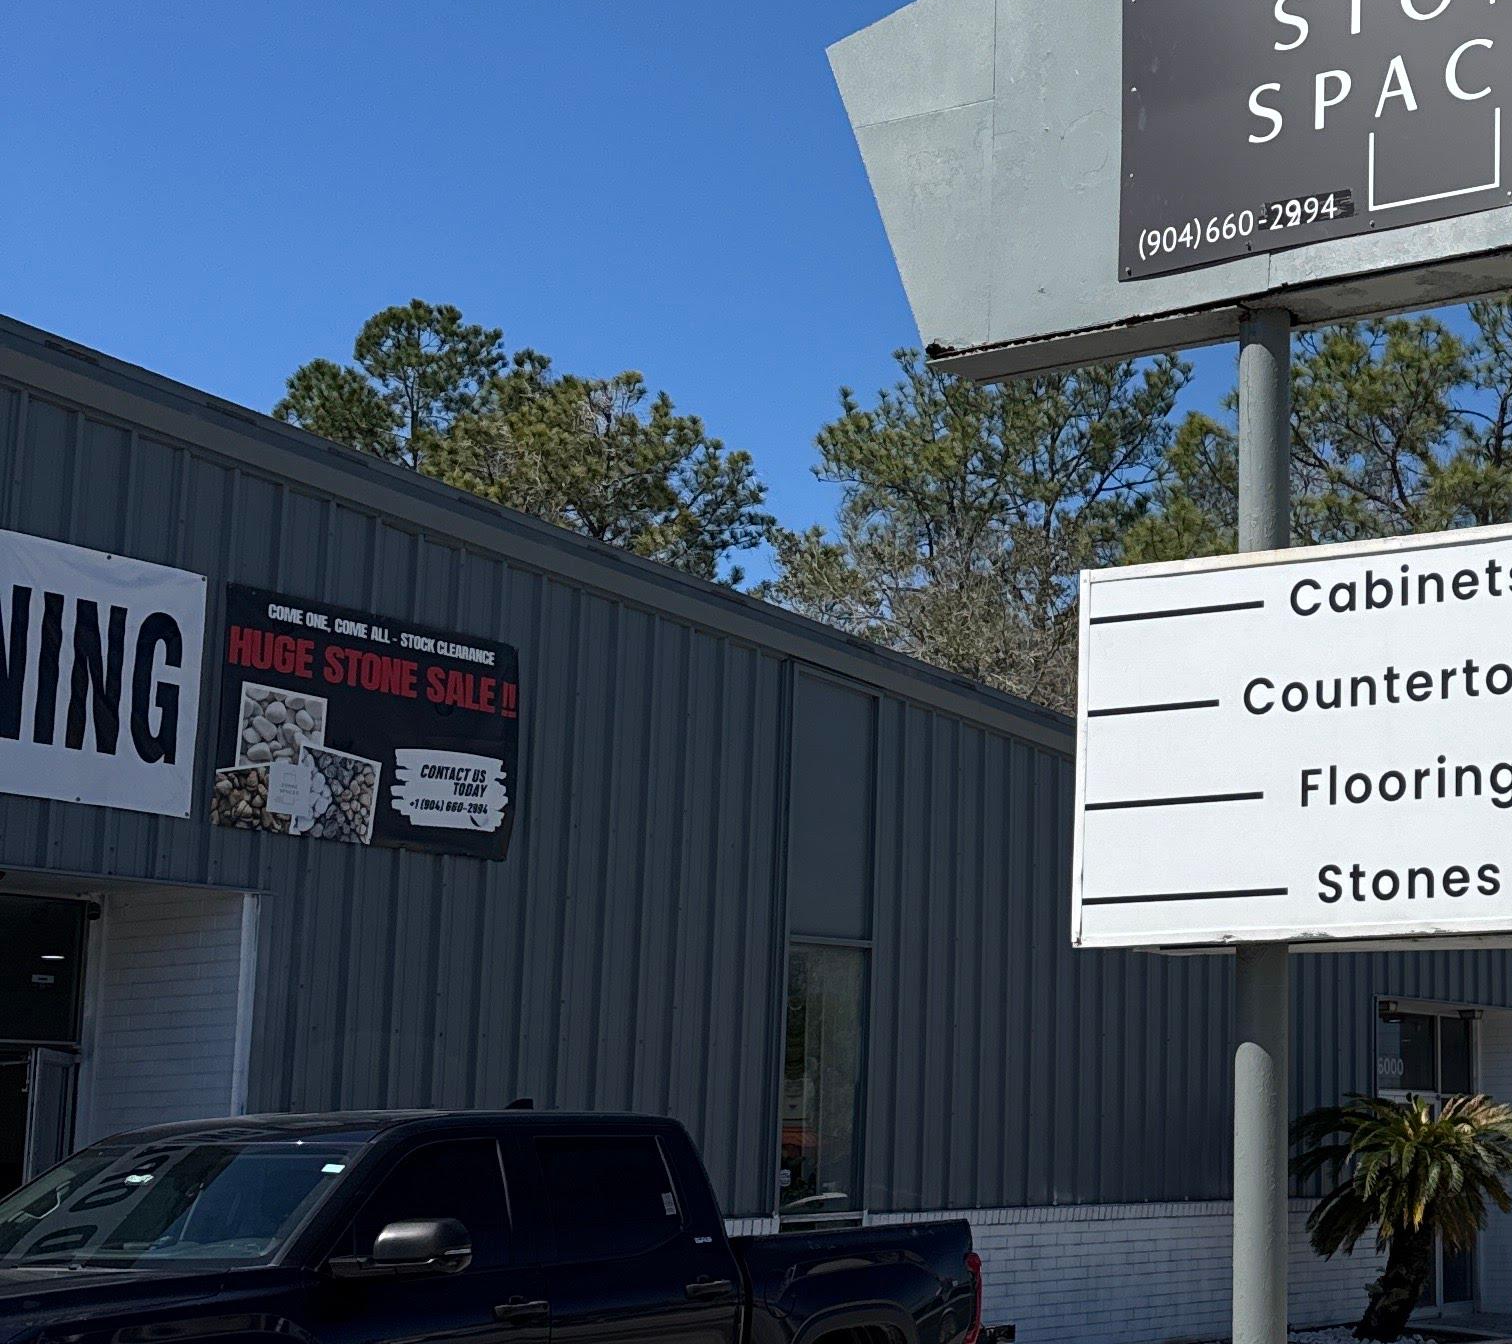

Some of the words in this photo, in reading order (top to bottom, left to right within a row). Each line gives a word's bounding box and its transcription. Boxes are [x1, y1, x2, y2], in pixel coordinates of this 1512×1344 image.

[268, 603, 304, 625] COME
[305, 612, 331, 633] ONE,
[334, 618, 368, 639] COME
[371, 626, 390, 644] ALL
[400, 632, 436, 654] STOCK
[436, 640, 495, 666] CLEARANCE
[229, 625, 315, 679] HUGE
[323, 645, 418, 699] STONE
[426, 666, 496, 714] SALE
[501, 681, 517, 718] !!
[420, 764, 471, 782] CONTACT
[472, 769, 487, 783] US
[409, 799, 420, 809] +1
[453, 782, 488, 797] TODAY
[1318, 863, 1502, 905] Stones
